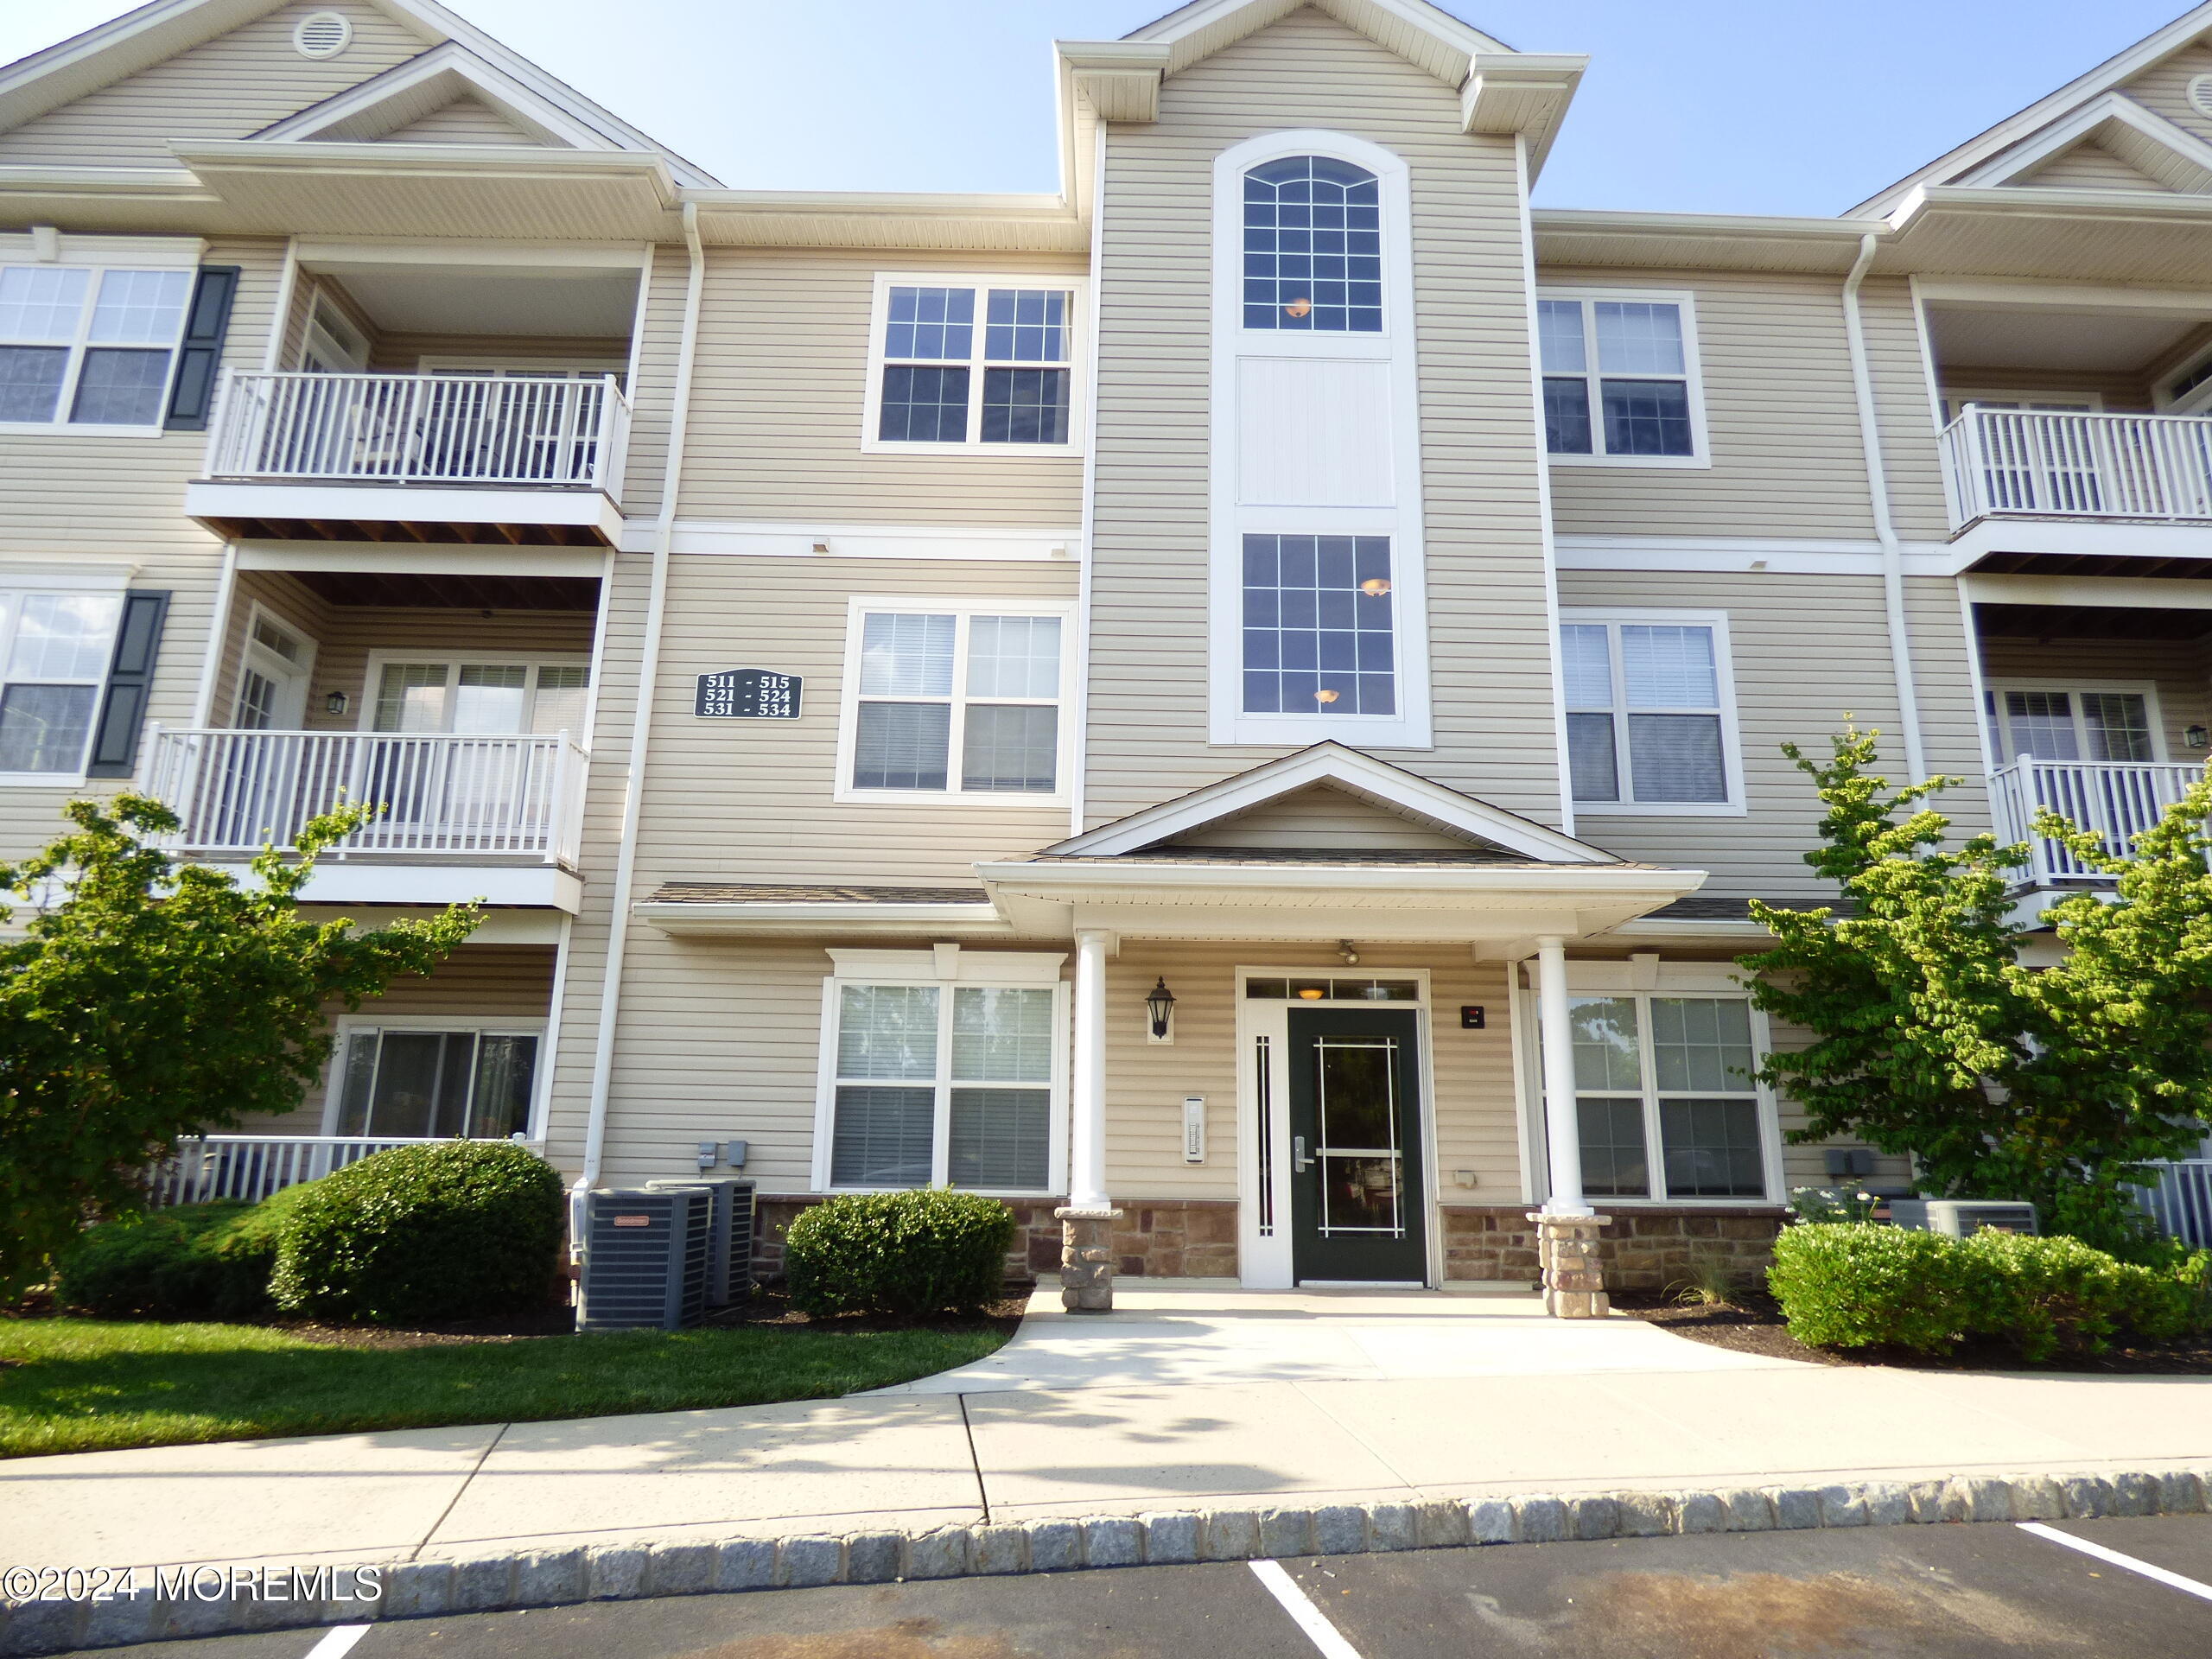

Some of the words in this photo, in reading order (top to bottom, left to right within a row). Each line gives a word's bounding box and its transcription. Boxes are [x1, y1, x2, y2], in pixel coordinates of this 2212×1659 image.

[706, 676, 734, 688] 511
[759, 677, 790, 689] 515
[705, 690, 734, 702] 521
[759, 690, 791, 702] 524
[703, 703, 733, 715] 531
[758, 704, 791, 715] 534
